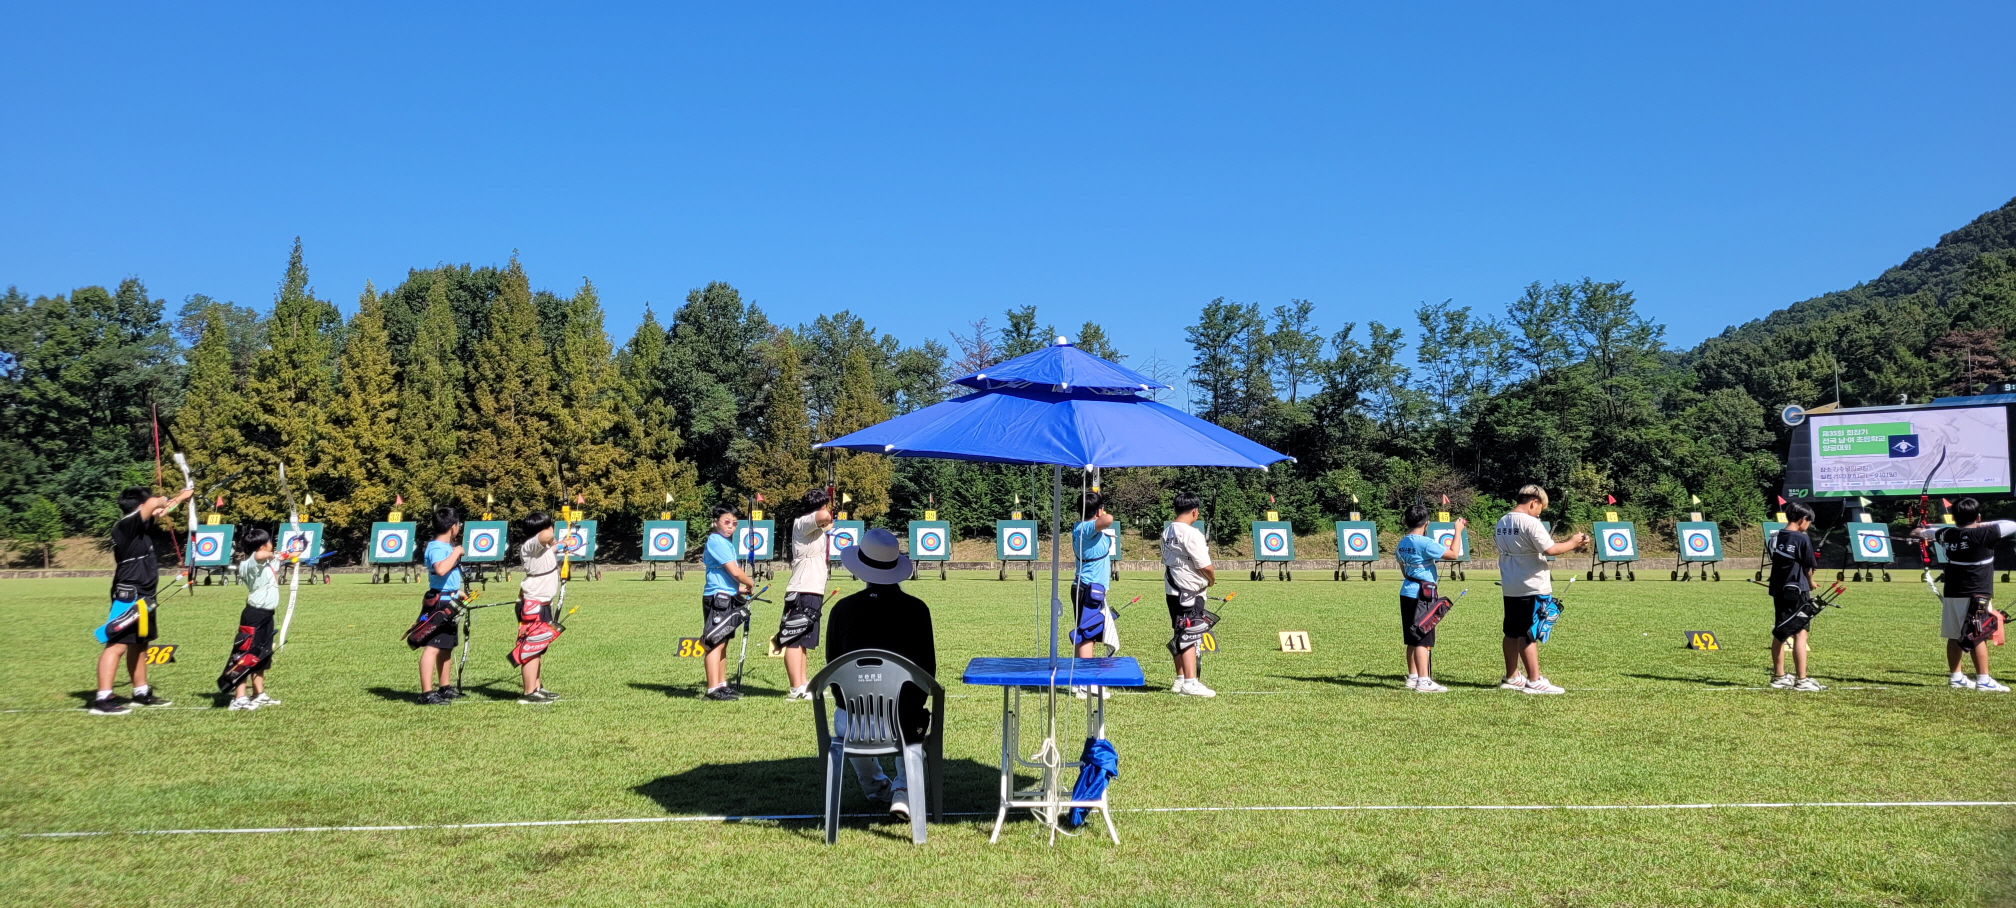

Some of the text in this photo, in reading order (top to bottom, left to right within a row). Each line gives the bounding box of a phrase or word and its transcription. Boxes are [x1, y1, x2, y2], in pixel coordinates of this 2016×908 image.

[1856, 435, 1886, 443] 초등학교
[210, 515, 218, 524] 31
[299, 514, 309, 522] 32
[482, 513, 492, 521] 34
[662, 512, 671, 520] 36
[1284, 634, 1309, 651] 41
[1692, 633, 1720, 651] 42
[679, 639, 706, 658] 38
[145, 646, 174, 665] 36
